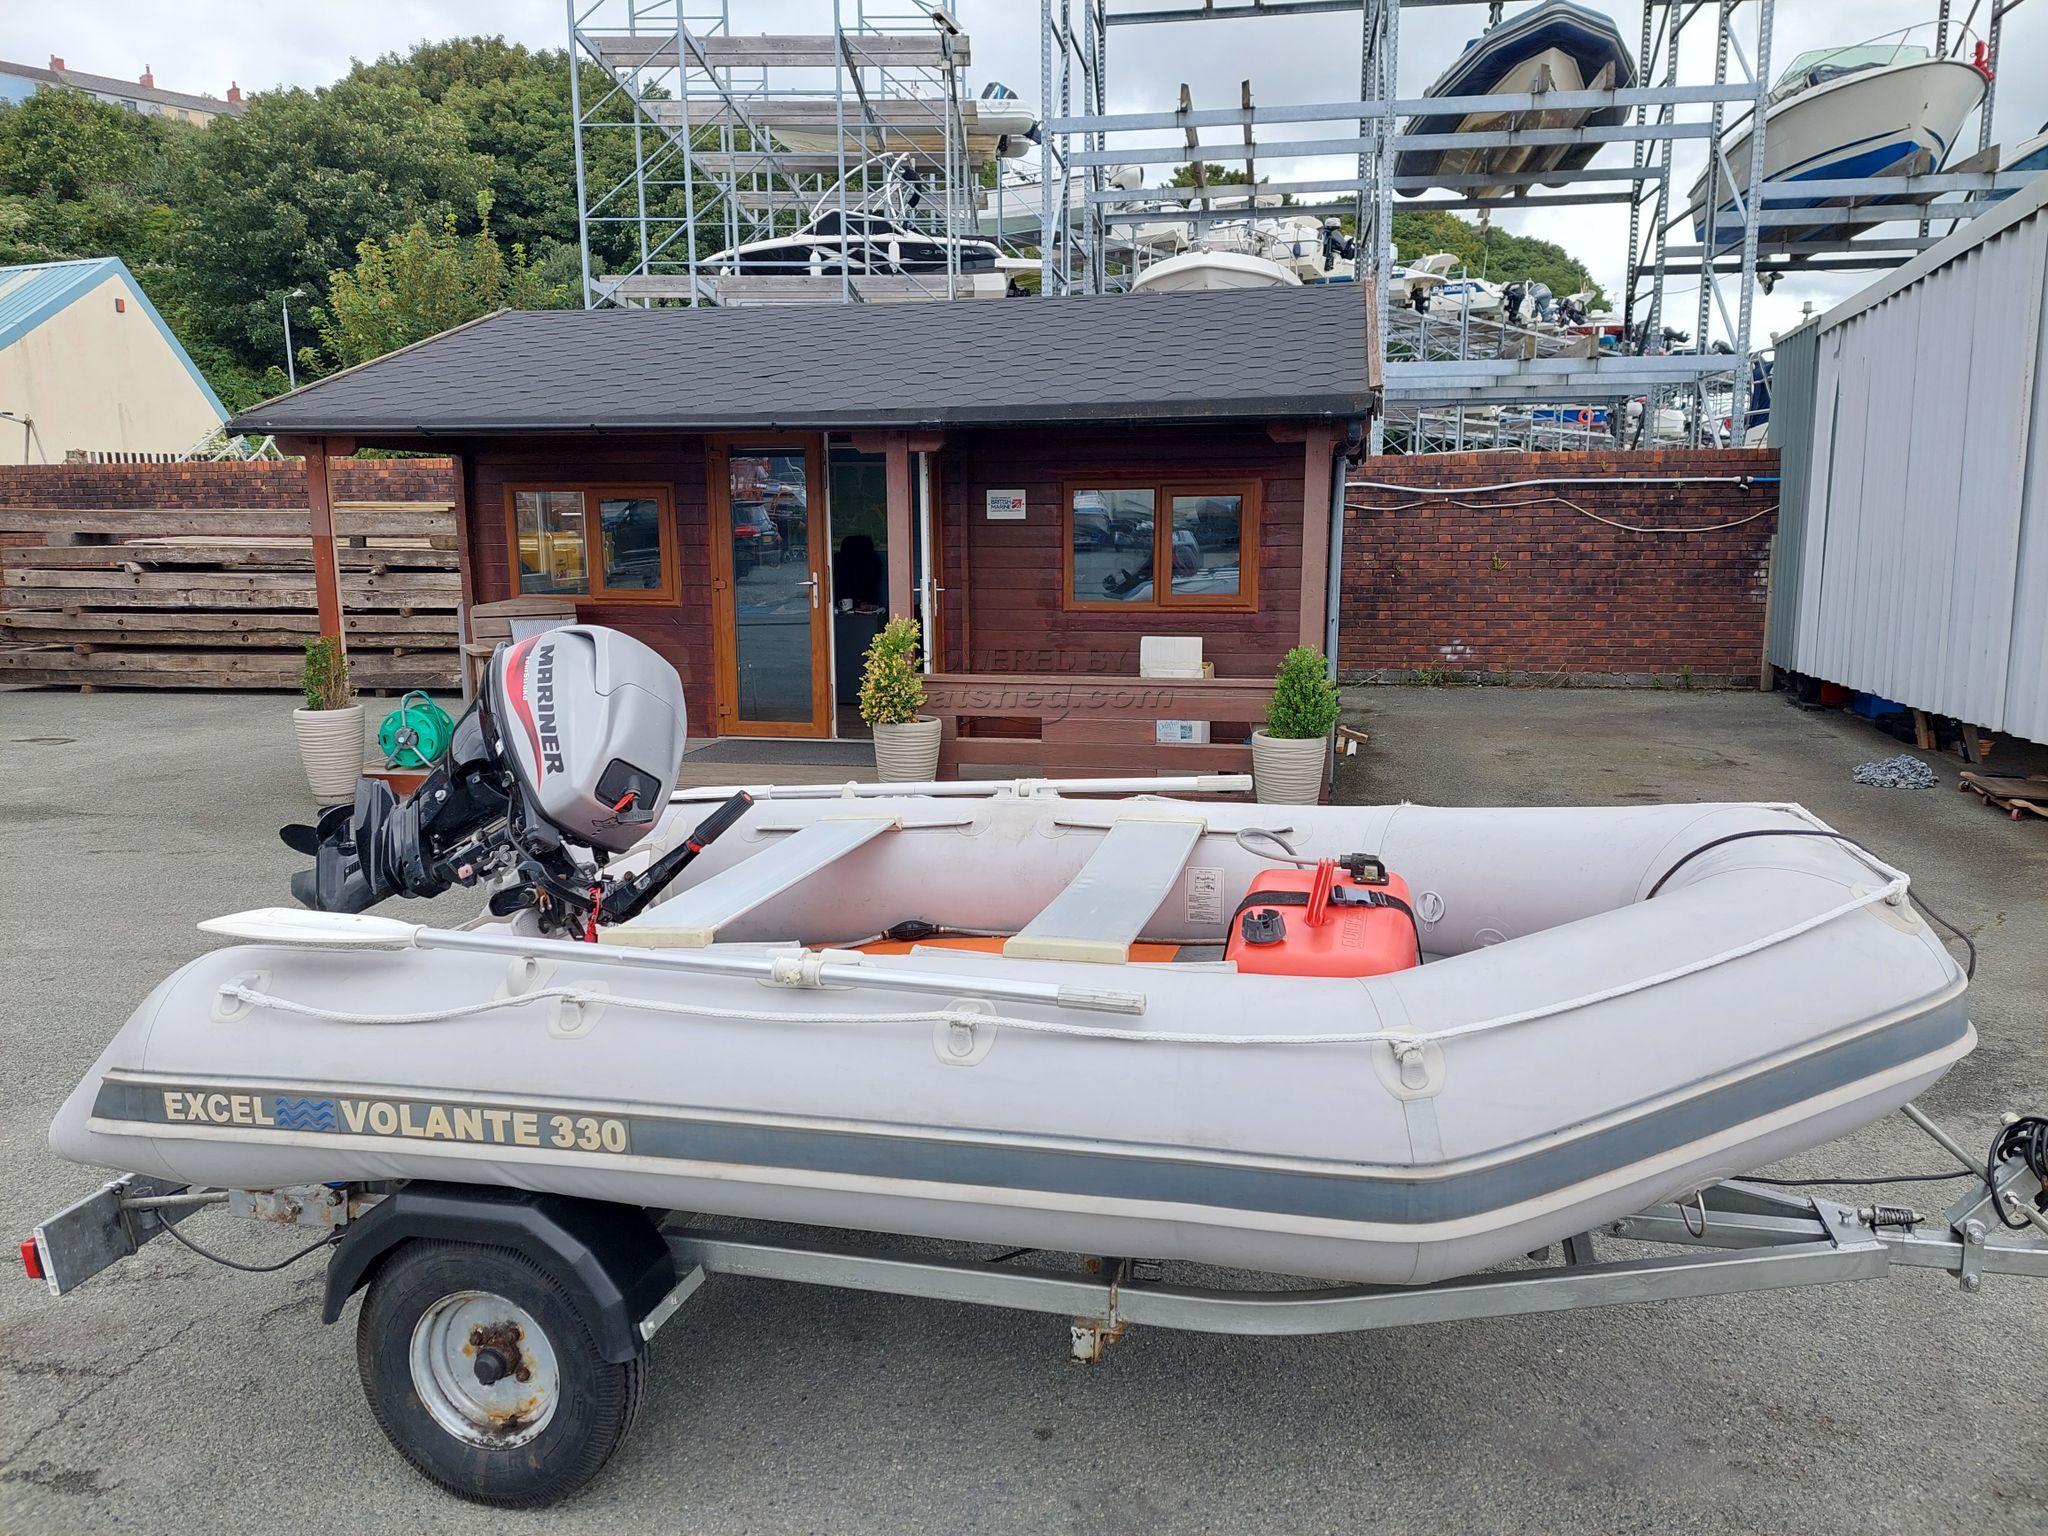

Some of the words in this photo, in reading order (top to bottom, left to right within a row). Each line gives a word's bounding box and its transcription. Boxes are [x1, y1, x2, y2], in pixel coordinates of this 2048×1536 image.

[538, 645, 564, 775] MARINER
[164, 1092, 275, 1126] EXCEL
[340, 1100, 540, 1146] VOLANTE
[550, 1107, 627, 1153] 330
